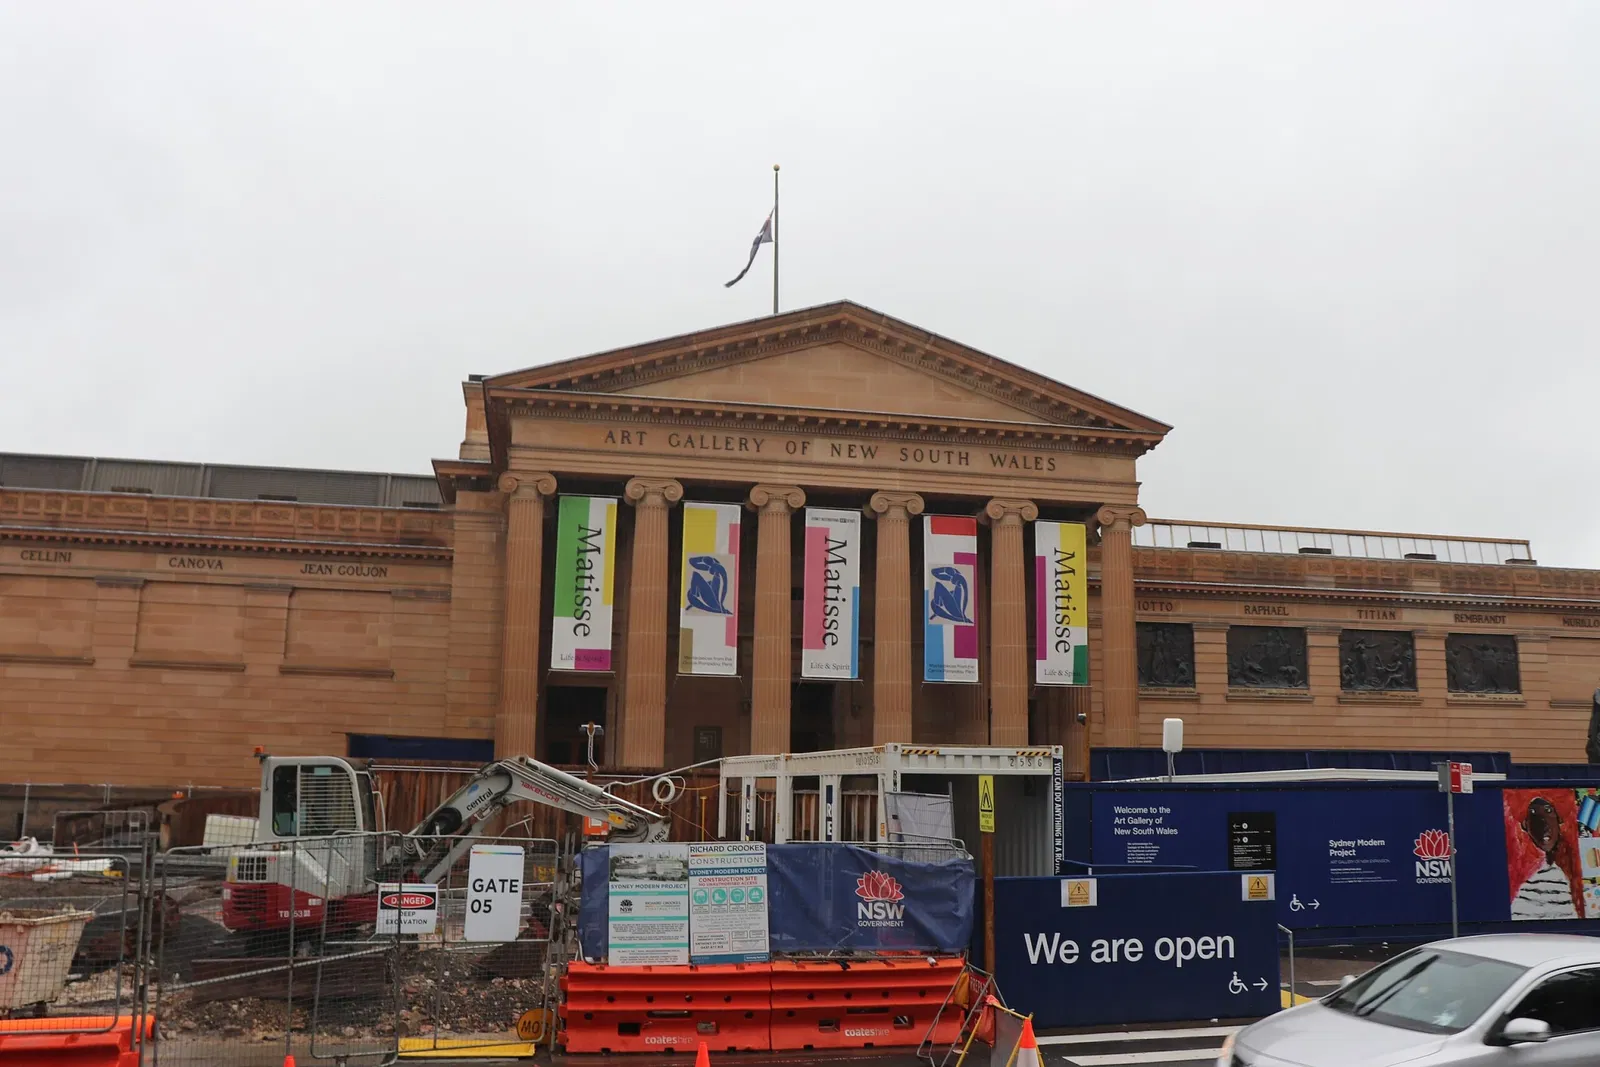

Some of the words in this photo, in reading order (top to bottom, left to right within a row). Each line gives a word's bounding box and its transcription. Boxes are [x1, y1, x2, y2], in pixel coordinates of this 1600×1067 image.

[604, 430, 647, 446] ART
[668, 433, 765, 452] GALLERY
[786, 440, 810, 455] OF
[830, 443, 878, 460] NEW
[899, 447, 970, 466] SOUTH
[989, 452, 1056, 471] WALES
[20, 550, 72, 563] CELLINI
[168, 557, 224, 570] CANOVA
[300, 563, 334, 576] JEAN
[573, 524, 602, 637] Matisse
[822, 535, 848, 646] Matisse
[1054, 546, 1076, 654] Matisse
[1138, 601, 1173, 612] IOTTO
[1244, 604, 1290, 616] RAPHAEL
[1356, 608, 1396, 620] TITIAN
[1454, 613, 1506, 625] REMBRANDT
[1562, 616, 1600, 628] MURILLO
[466, 788, 494, 812] central
[1054, 792, 1062, 802] DO
[1128, 817, 1153, 826] Gallery
[1329, 839, 1356, 848] Sydney
[1330, 849, 1356, 857] Project
[690, 857, 765, 865] CONSTRUCTIONS
[1415, 861, 1452, 877] NSW
[472, 878, 519, 893] GATE
[471, 899, 492, 913] 05
[858, 902, 905, 920] NSW
[1024, 932, 1079, 965] We
[1090, 938, 1144, 963] are
[1154, 935, 1235, 968] open
